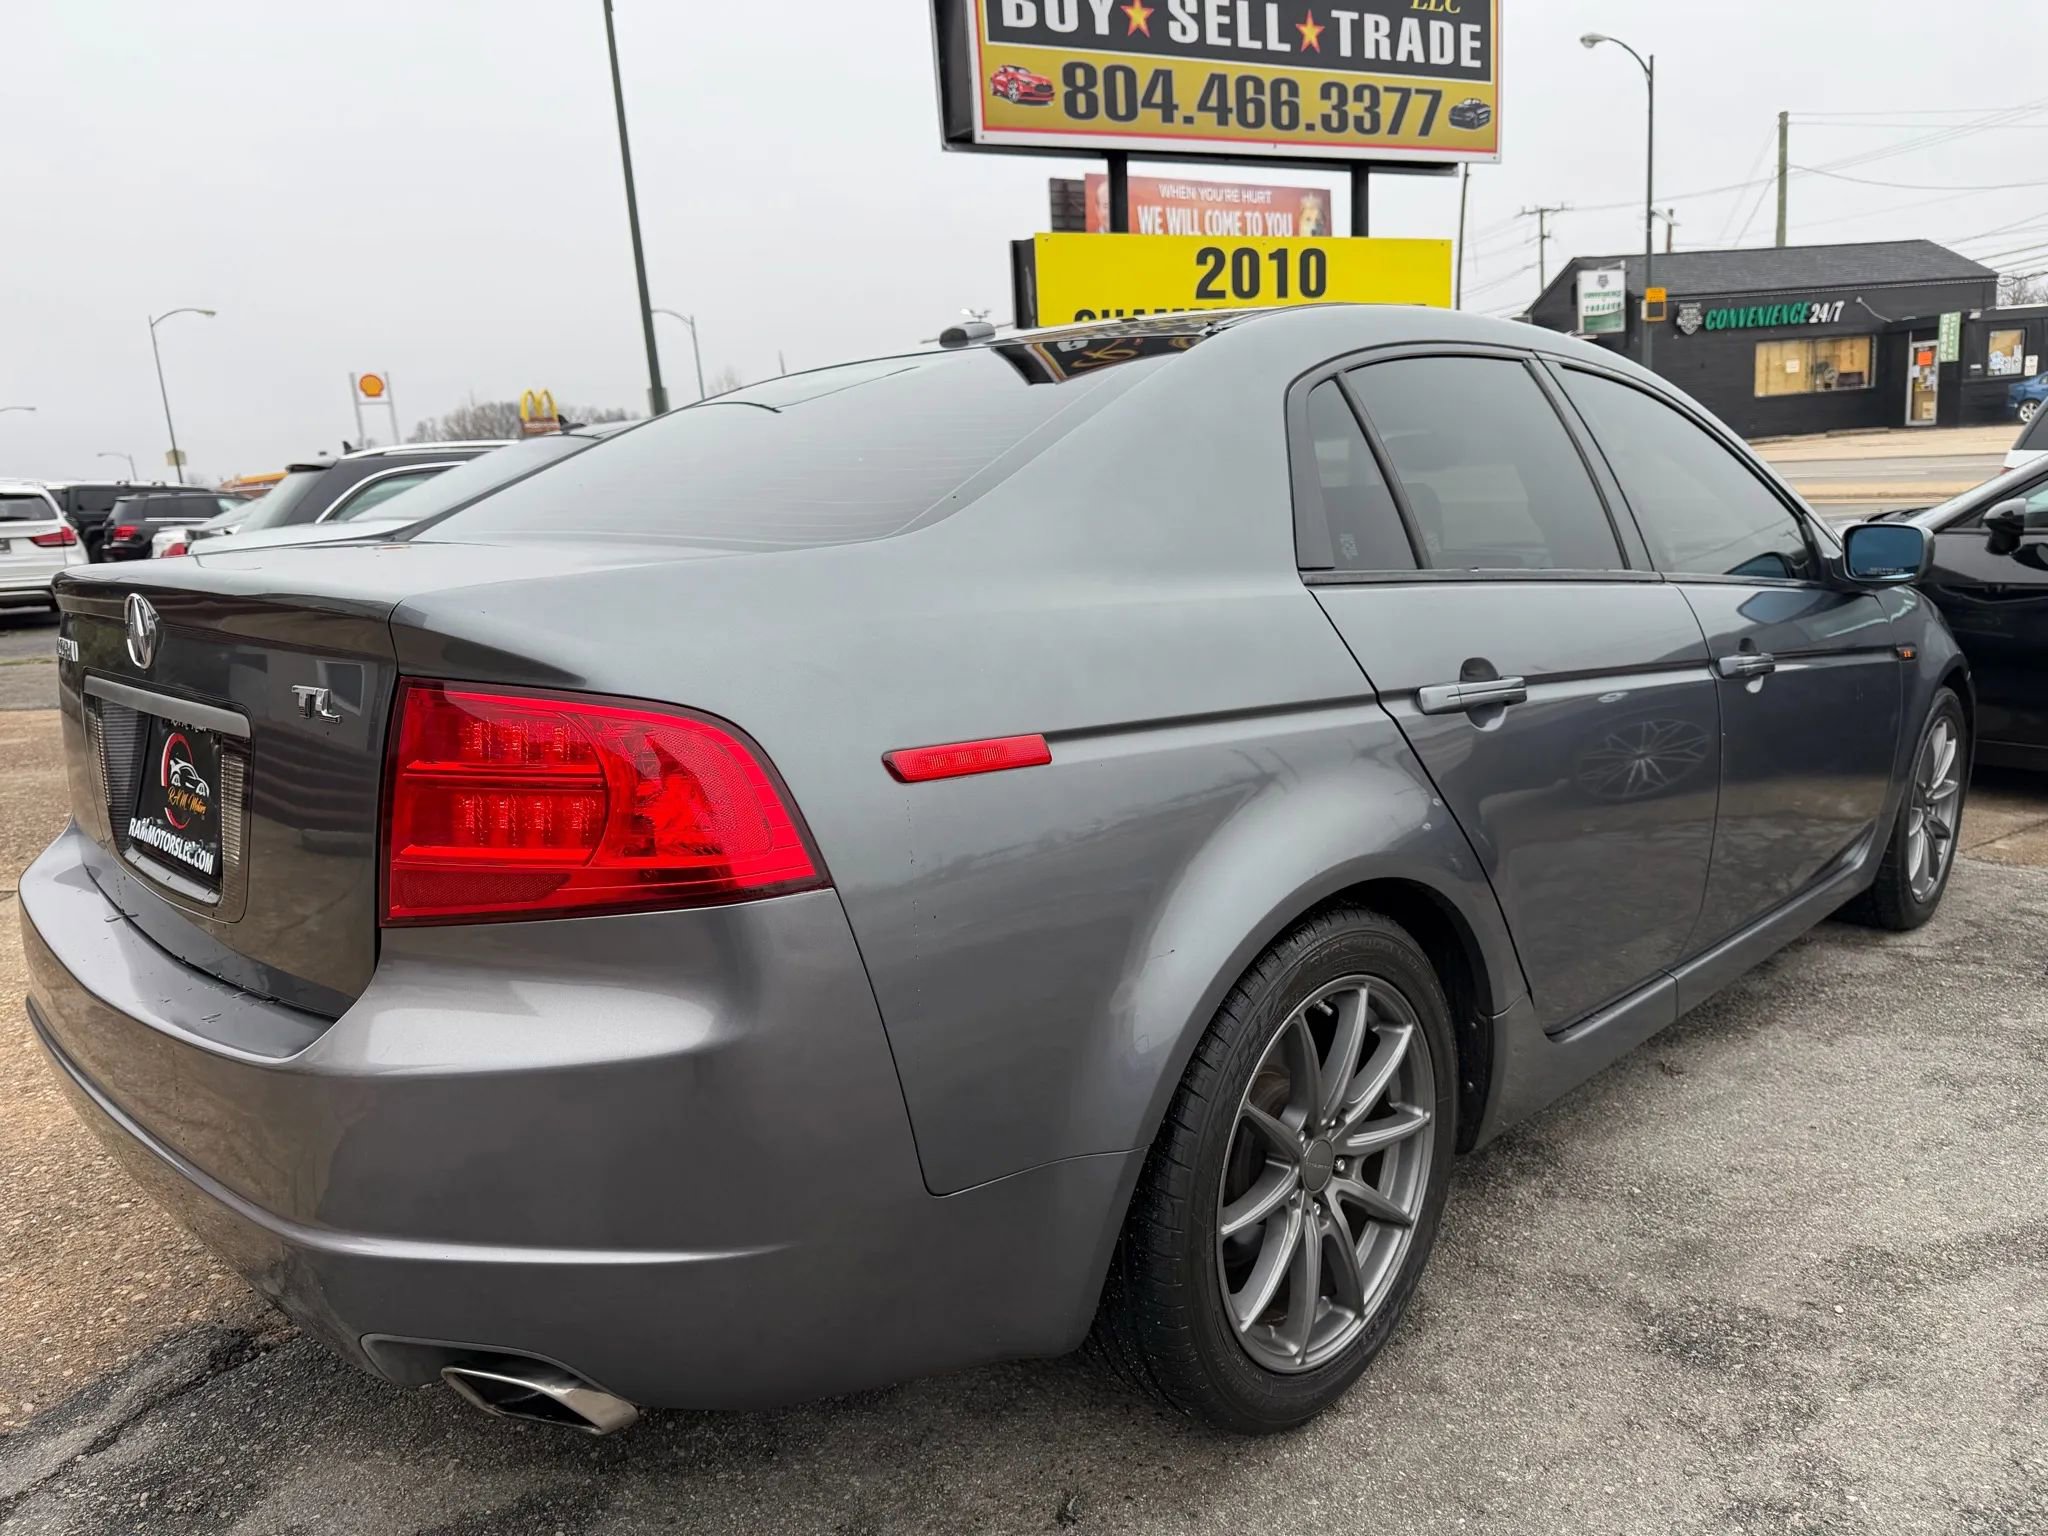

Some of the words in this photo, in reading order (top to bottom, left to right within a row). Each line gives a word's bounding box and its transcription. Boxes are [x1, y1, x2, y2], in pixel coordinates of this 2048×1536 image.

[1168, 0, 1292, 52] SELL
[1331, 9, 1483, 68] TRADE
[1062, 61, 1444, 137] 804.466.3377
[1158, 183, 1196, 200] WHEN
[1198, 186, 1241, 204] YOU'RE
[1241, 189, 1273, 204] HURT
[1137, 204, 1164, 236] WE
[1165, 206, 1201, 237] WILL
[1203, 208, 1242, 237] COME
[1245, 210, 1263, 237] TO
[1265, 212, 1293, 237] YOU
[1195, 246, 1328, 300] 2010
[1704, 301, 1810, 331] CONVENIENCE
[1808, 300, 1845, 324] 24/7
[292, 684, 342, 723] TL
